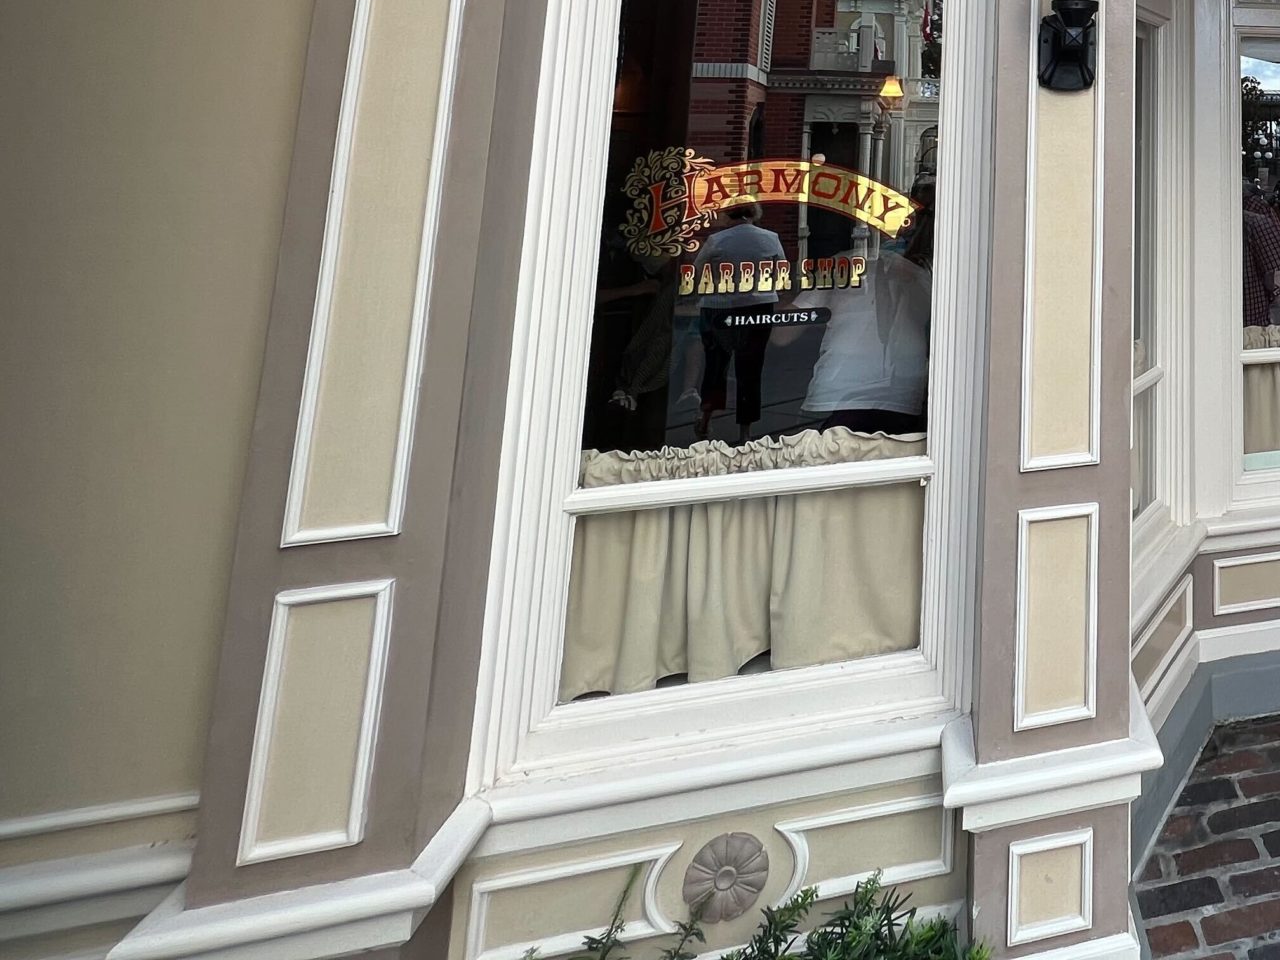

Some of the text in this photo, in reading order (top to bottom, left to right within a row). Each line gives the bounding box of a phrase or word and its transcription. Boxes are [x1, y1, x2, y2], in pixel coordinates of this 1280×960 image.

[648, 167, 904, 235] HARMONY
[678, 256, 867, 296] BARBER SHOP
[734, 311, 809, 326] HAIRCUTS
